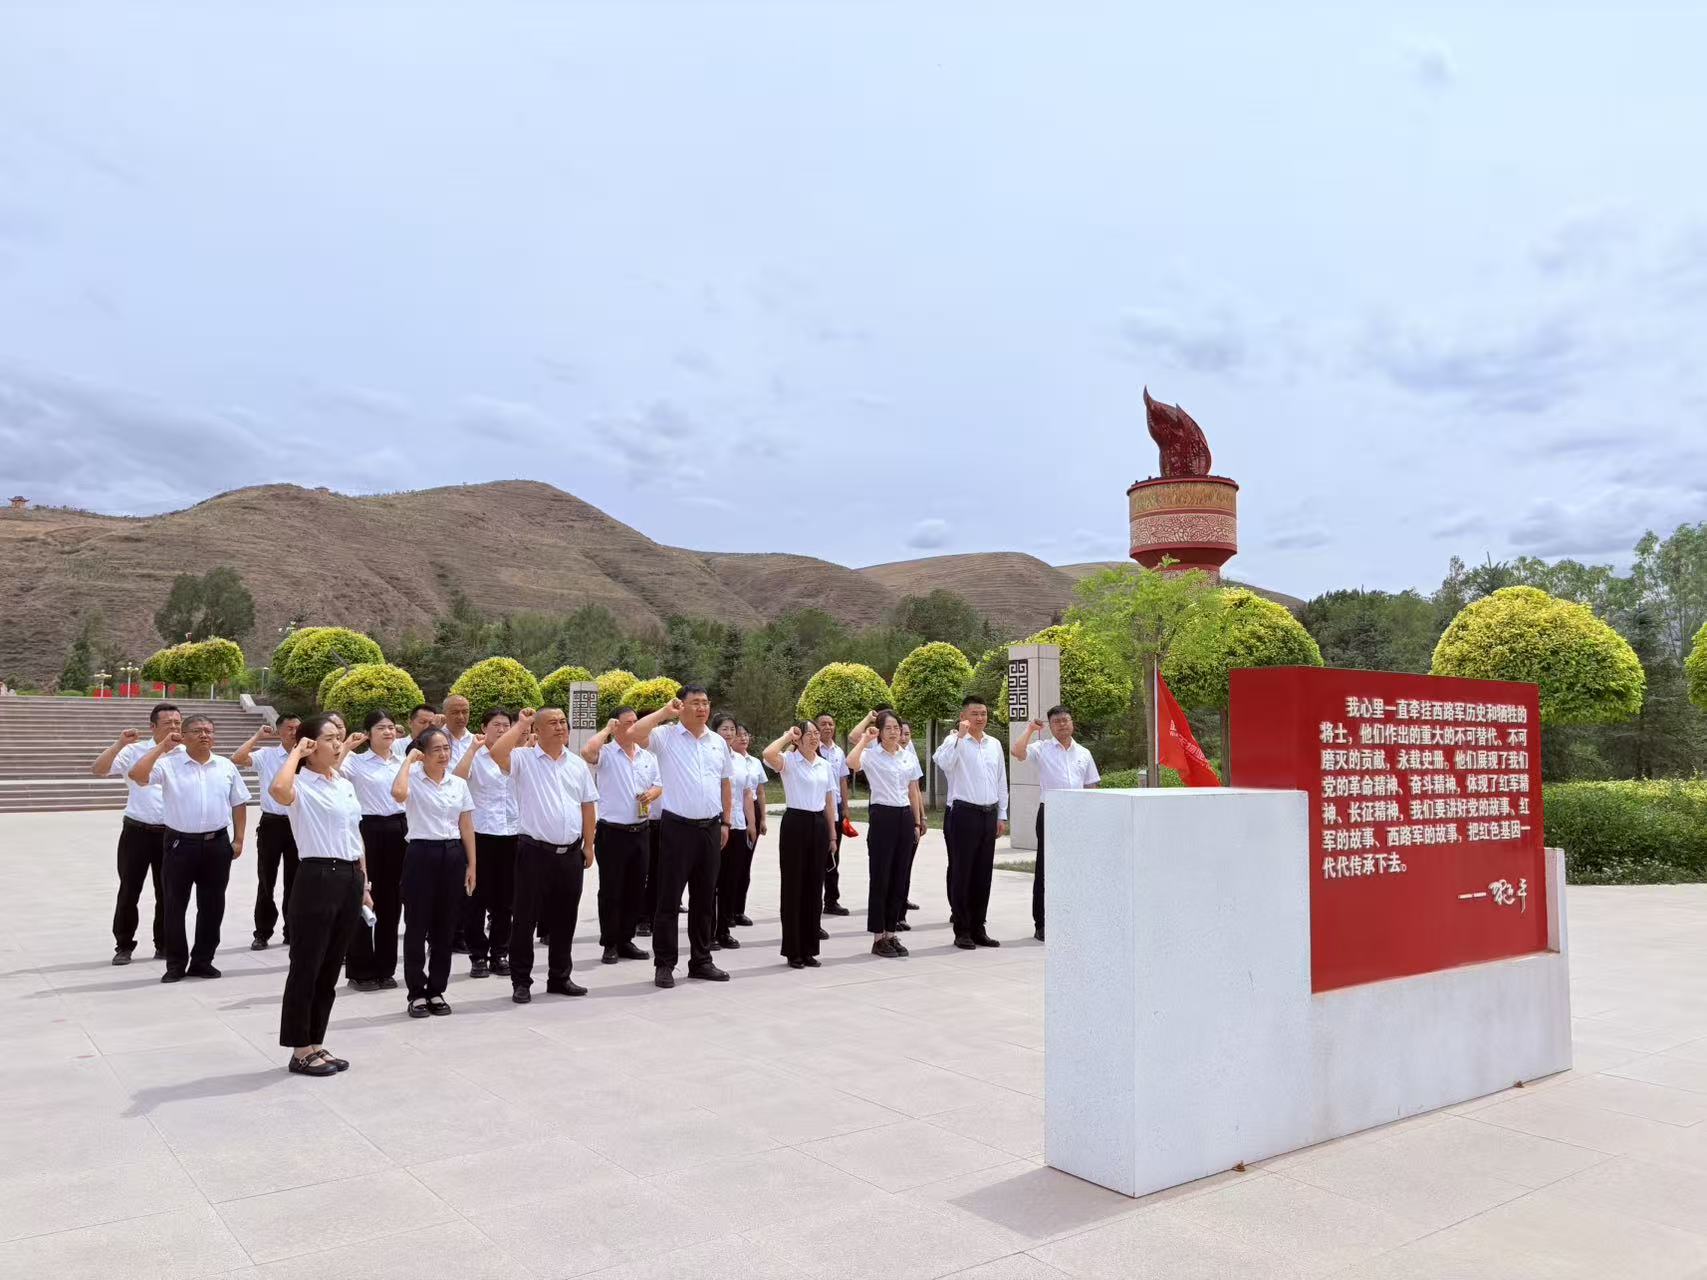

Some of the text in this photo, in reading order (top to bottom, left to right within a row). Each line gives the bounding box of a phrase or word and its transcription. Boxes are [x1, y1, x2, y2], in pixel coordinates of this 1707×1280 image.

[1345, 696, 1527, 723] 我心里一直牵挂西路军历史和牺牲的
[1319, 721, 1528, 746] 将士，他们作出的重大的不可替代、不可
[1321, 748, 1528, 771] 磨灭的贡献，永载史册。他们展现了我们
[1321, 774, 1530, 798] 党的革命精神、奋斗精神，体现了红军精
[1322, 797, 1530, 825] 神、长征精神，我们要讲好党的故事、红
[1323, 852, 1407, 879] 代代传承下去。
